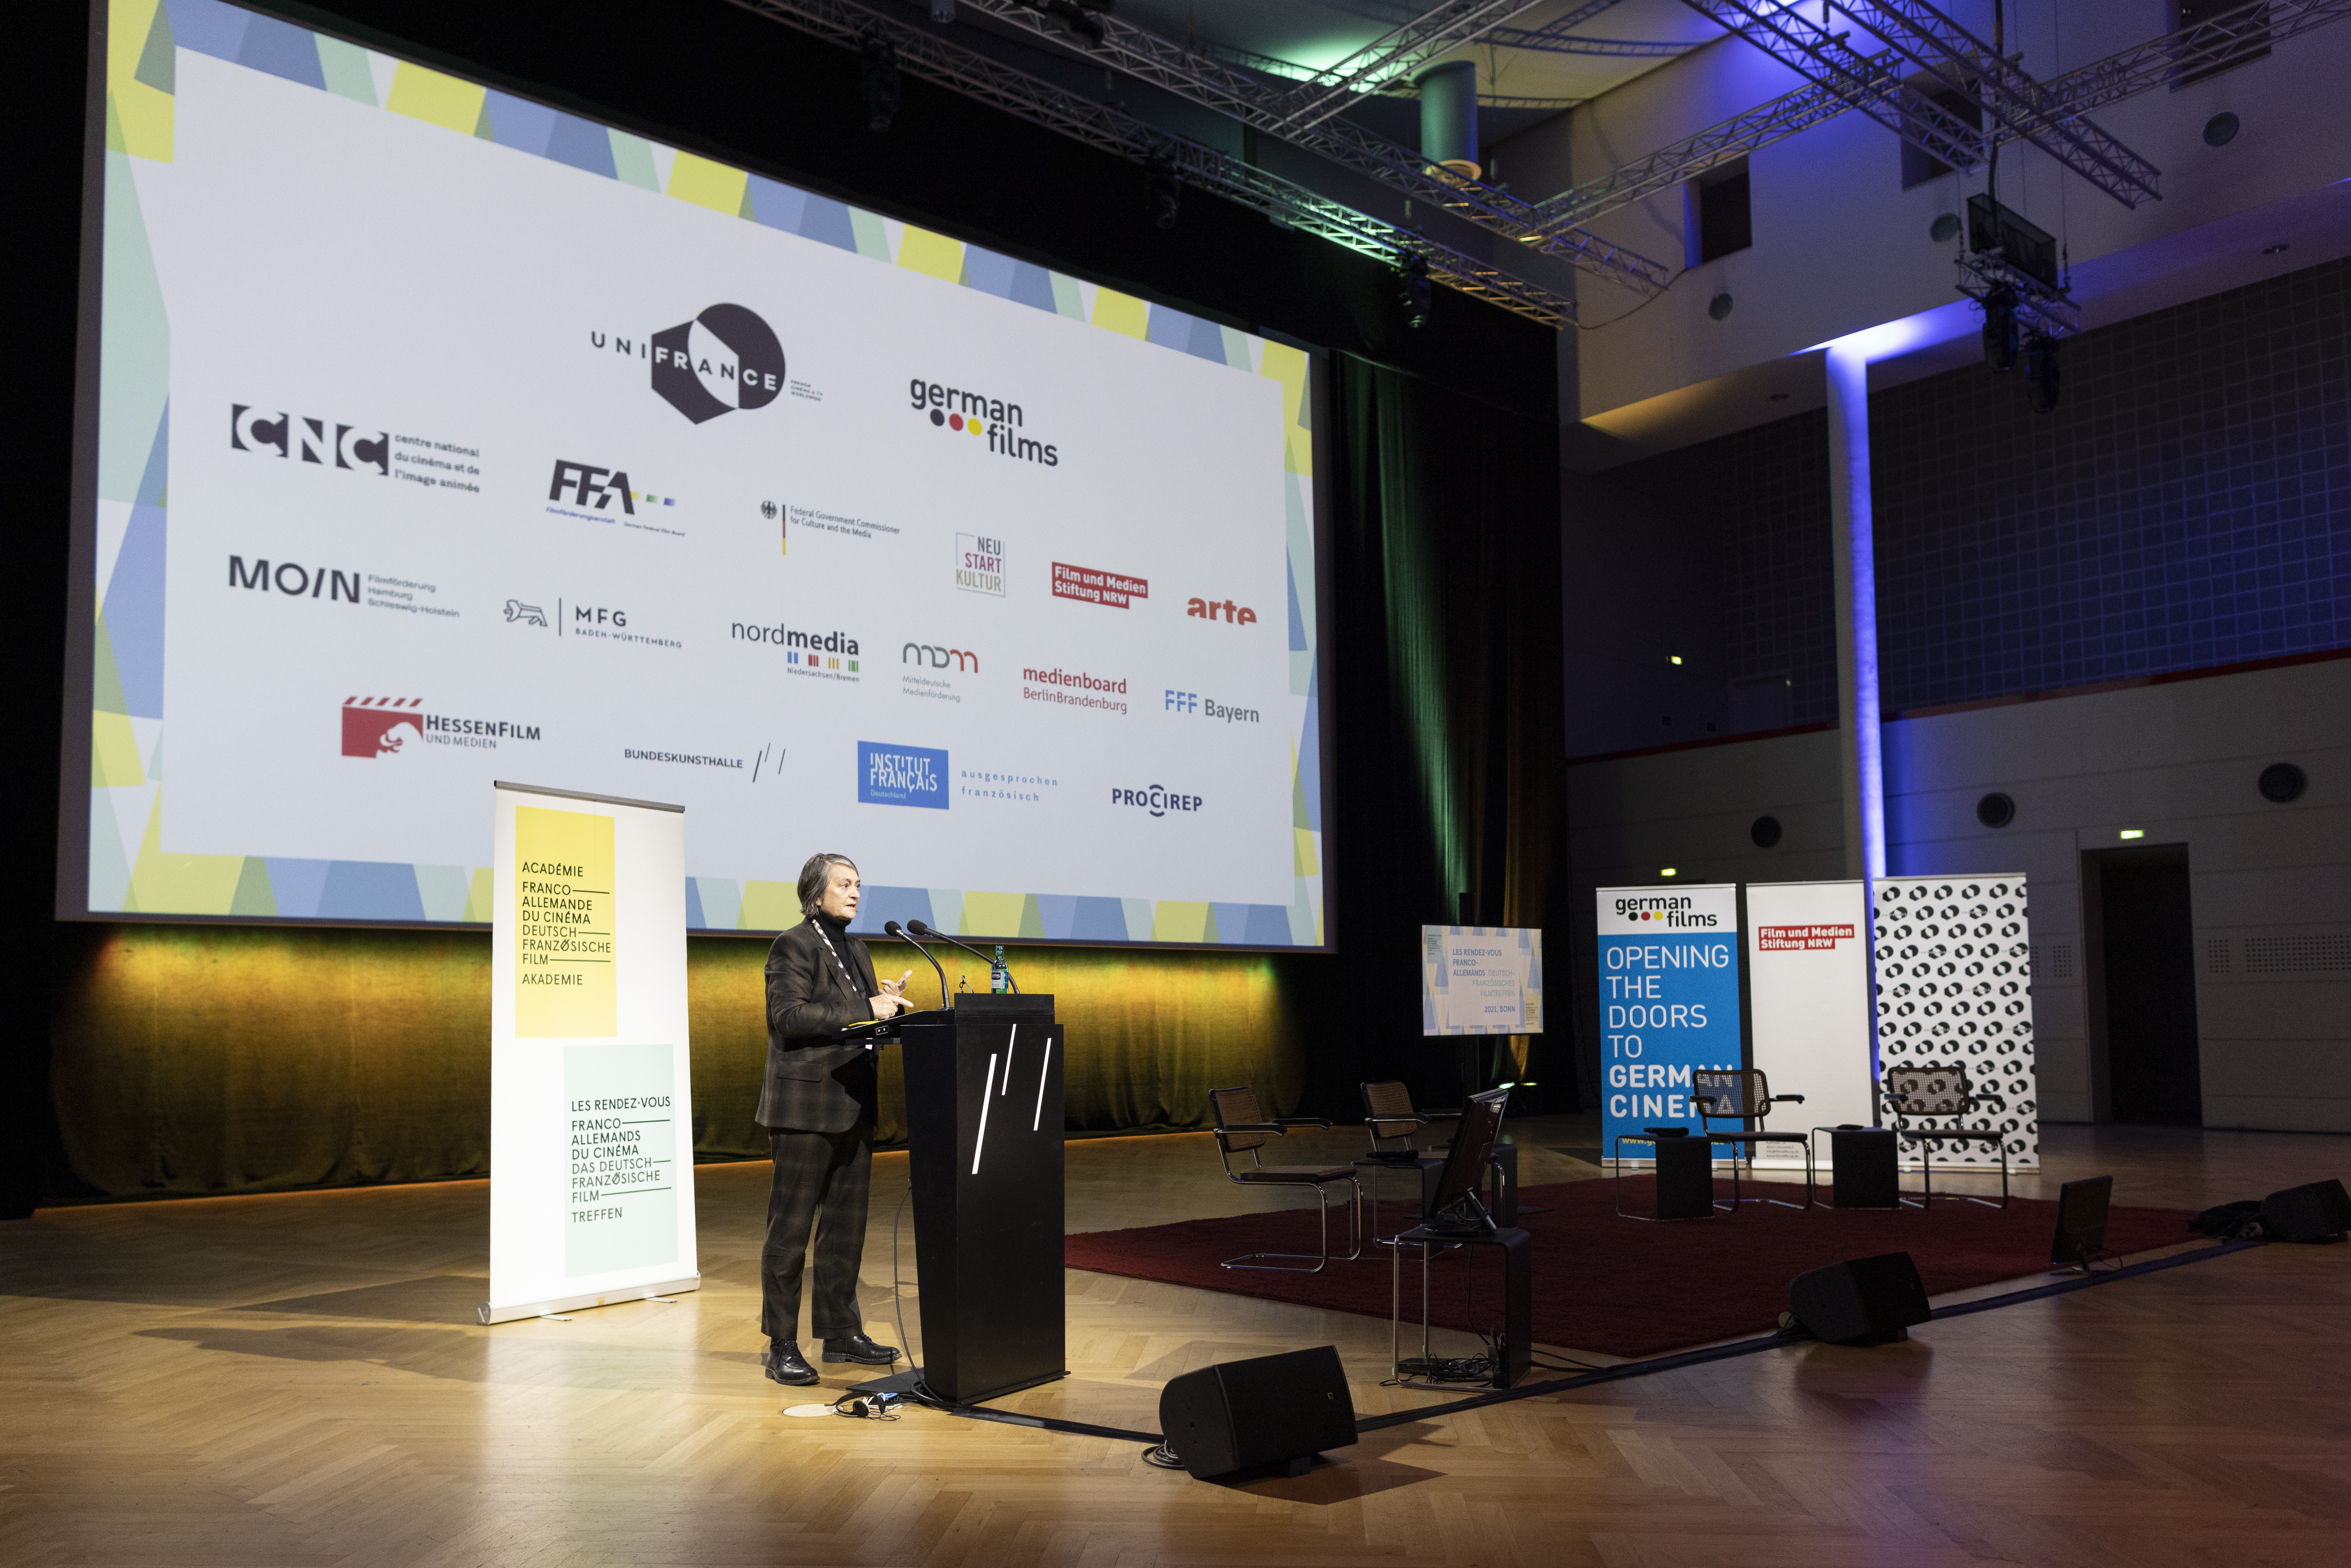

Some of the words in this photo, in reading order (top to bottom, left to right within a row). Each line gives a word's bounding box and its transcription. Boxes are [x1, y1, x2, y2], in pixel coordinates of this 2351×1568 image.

[592, 331, 776, 391] UNIFRANCE
[910, 378, 1022, 427] german
[231, 403, 389, 476] CNC
[394, 434, 432, 448] centre
[434, 441, 480, 457] national
[987, 423, 1058, 466] films
[394, 452, 409, 462] du
[411, 454, 452, 470] cinéma
[454, 463, 465, 473] et
[467, 465, 480, 475] de
[440, 479, 480, 493] animée
[549, 459, 635, 515] FFA
[790, 505, 814, 517] Federal
[816, 511, 855, 526] Government
[857, 519, 900, 534] Commissioner
[790, 516, 799, 524] for
[801, 517, 825, 529] Culture
[827, 524, 838, 532] and
[840, 526, 850, 534] the
[852, 528, 871, 538] Media
[978, 536, 1001, 555] NEU
[965, 552, 1002, 573] START
[368, 574, 436, 592] Filmförderung
[956, 568, 1001, 591] KULTUR
[1055, 566, 1081, 582] Film
[1083, 572, 1104, 586] und
[1106, 575, 1146, 594] Medien
[368, 586, 413, 601] Hamburg
[1055, 581, 1100, 602] Stiftung
[1103, 591, 1127, 604] NRW
[368, 598, 460, 617] Schleswig-Holstein
[576, 605, 626, 627] MFG
[1187, 597, 1257, 626] arte
[732, 622, 859, 655] nordmedia
[787, 667, 860, 682] Niedersachsen/Bremen
[903, 675, 950, 688] Mitteldeutsche
[1023, 668, 1127, 694] medienboard
[903, 686, 961, 703] Medienförderung
[1023, 687, 1127, 715] BerlinBrandenburg
[1165, 690, 1197, 713] FFF
[1205, 698, 1260, 723] Bayern
[426, 733, 450, 745] UND
[453, 735, 497, 749] MEDIEN
[624, 749, 743, 768] BUNDESKUNSTHALLE
[870, 752, 931, 775] INSTITUT
[962, 769, 1057, 786] ausgesprochen
[870, 789, 906, 799] Deutschland
[962, 786, 1039, 802] französisch
[1112, 788, 1203, 812] PROCIREP
[522, 861, 584, 877] ACADÉMIE
[522, 896, 592, 911] ALLEMANDE
[1616, 897, 1691, 915] german
[522, 910, 539, 922] DU
[544, 911, 591, 924] CINÉMA
[1666, 910, 1717, 927] films
[1761, 928, 1786, 938] Film
[1788, 927, 1808, 937] und
[1811, 926, 1853, 937] Medien
[1761, 939, 1805, 950] Stiftung
[1808, 938, 1833, 947] NRW
[1607, 944, 1729, 969] OPENING
[522, 973, 583, 985] AKADEMIE
[1606, 975, 1661, 999] THE
[1609, 1004, 1707, 1028] DOORS
[1608, 1035, 1642, 1058] TO
[572, 1100, 591, 1111] LES
[595, 1096, 671, 1111] RENDEZ-VOUS
[571, 1130, 640, 1146] ALLEMANDS
[572, 1148, 589, 1160] DU
[593, 1144, 639, 1158] CINÉMA
[572, 1162, 595, 1174] DAS
[572, 1207, 622, 1223] TREFFEN
